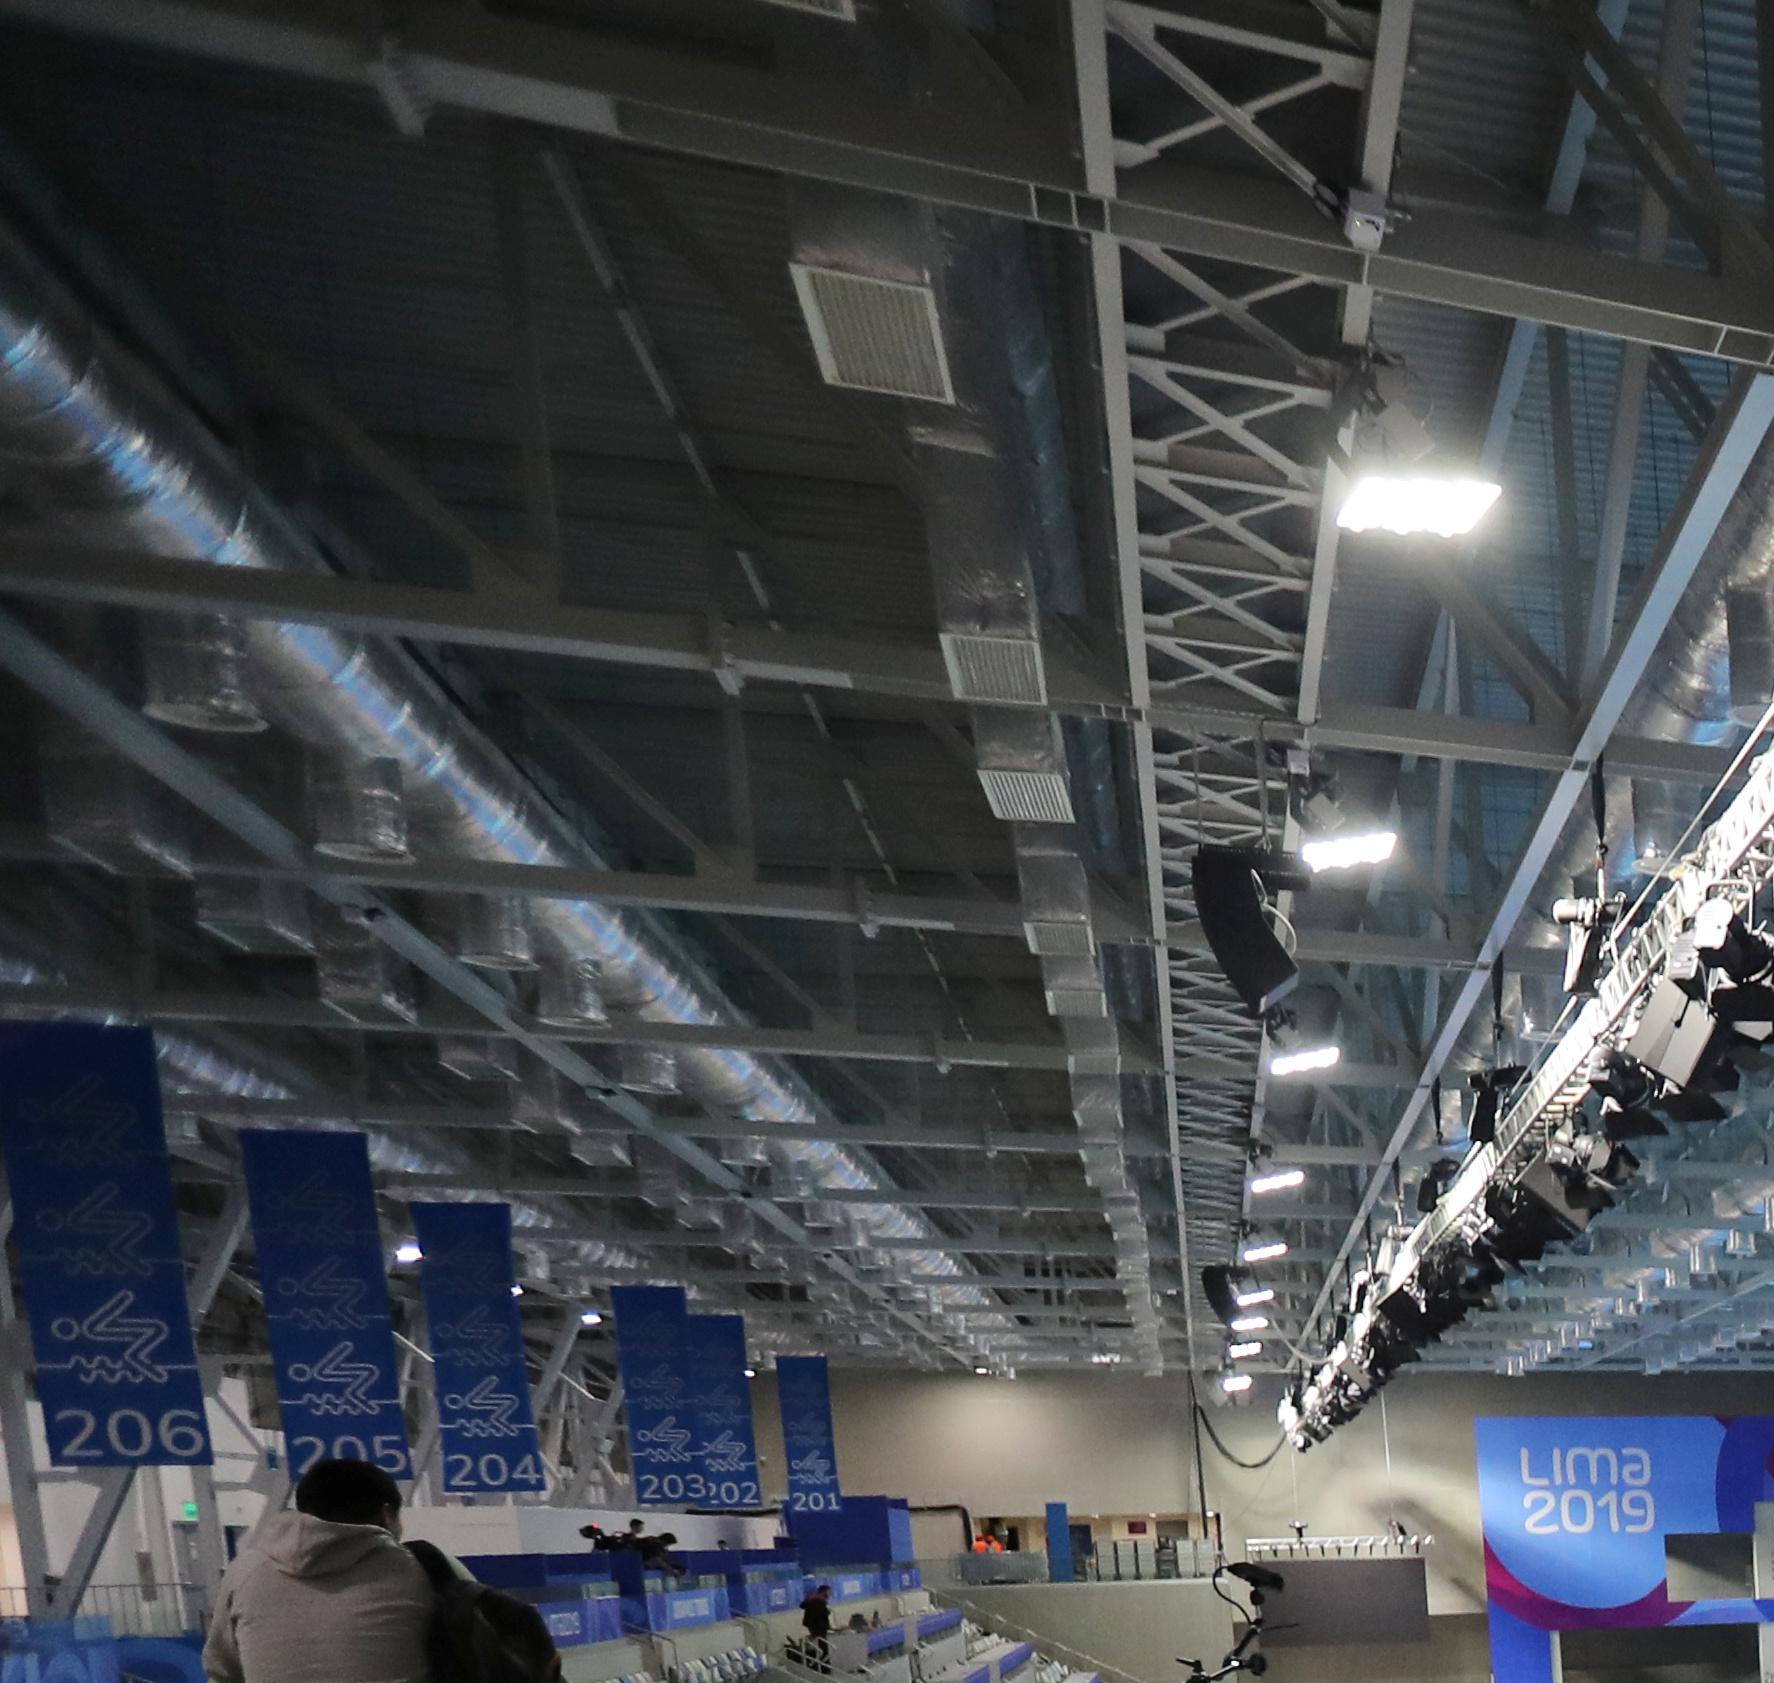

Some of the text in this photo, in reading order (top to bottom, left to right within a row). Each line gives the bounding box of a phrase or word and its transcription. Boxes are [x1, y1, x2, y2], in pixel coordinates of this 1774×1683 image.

[55, 1408, 205, 1458] 206
[292, 1434, 408, 1475] 205
[446, 1453, 544, 1487] 204
[639, 1474, 706, 1499] 203
[794, 1492, 840, 1512] 201
[1523, 1488, 1656, 1535] 2019
